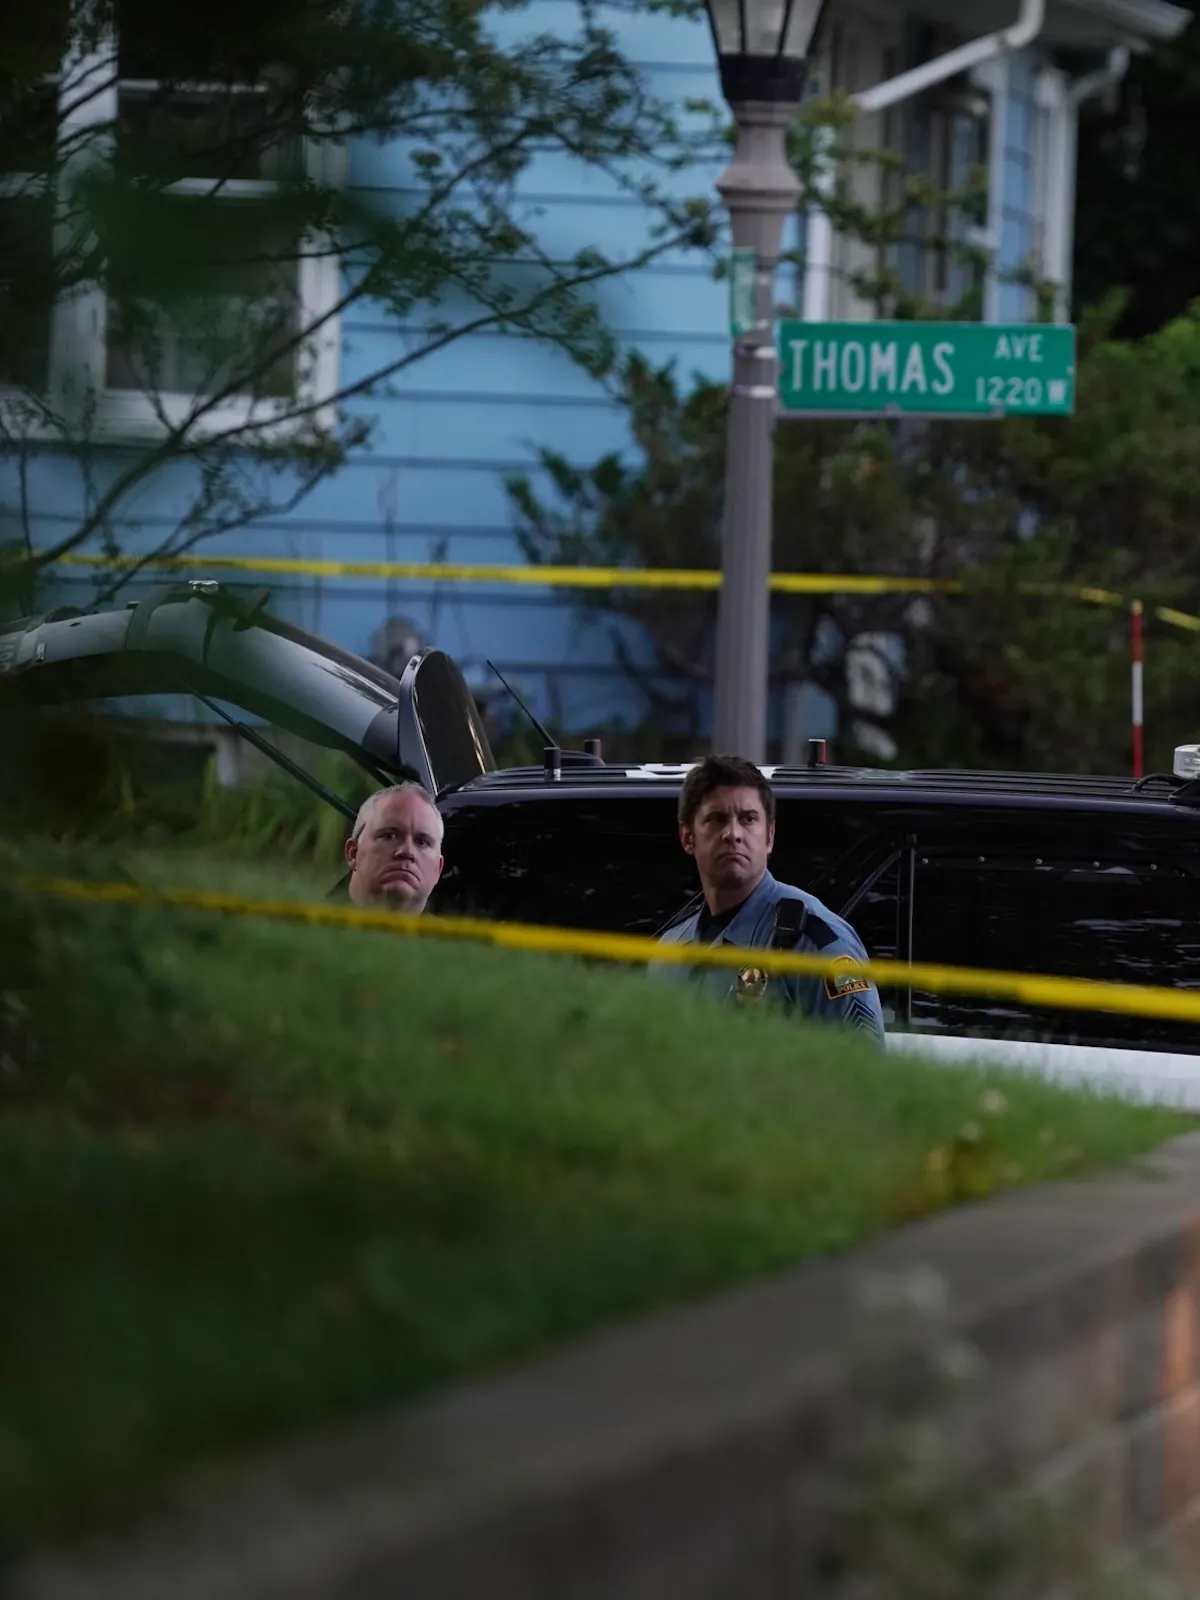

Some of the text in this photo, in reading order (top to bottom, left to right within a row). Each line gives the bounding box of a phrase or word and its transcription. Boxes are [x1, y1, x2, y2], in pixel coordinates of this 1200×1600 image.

[994, 333, 1044, 362] AVE
[788, 339, 956, 395] THOMAS
[976, 376, 1068, 406] 1220 W
[838, 982, 865, 993] POLICE
